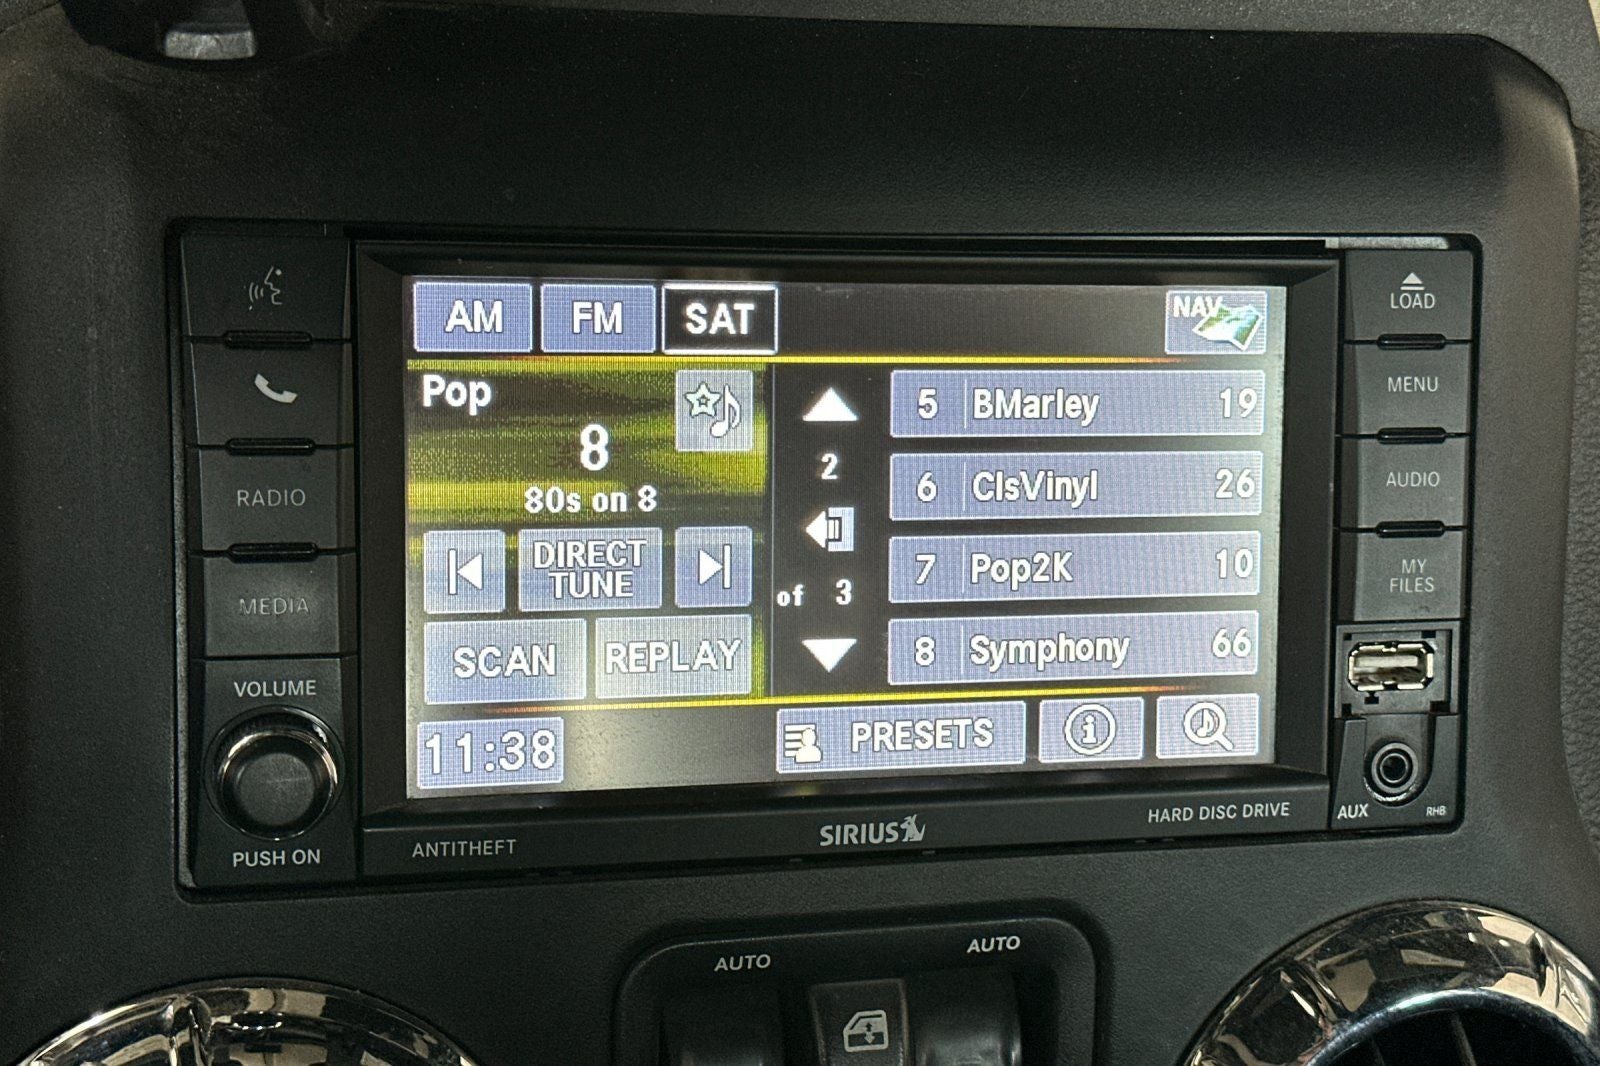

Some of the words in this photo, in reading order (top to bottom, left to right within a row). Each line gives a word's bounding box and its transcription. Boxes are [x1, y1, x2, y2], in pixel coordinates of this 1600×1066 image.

[1172, 296, 1224, 317] NAV
[1390, 293, 1435, 310] LOAD
[445, 300, 503, 333] AM
[572, 301, 623, 334] FM
[685, 303, 754, 335] SAT
[422, 375, 492, 415] Pop
[1387, 377, 1439, 393] MENU
[917, 388, 938, 419] 5
[973, 388, 1100, 426] BMarley
[1219, 388, 1258, 418] 19
[579, 424, 609, 471] 8
[820, 452, 839, 480] 2
[1386, 471, 1440, 487] AUDIO
[236, 489, 306, 507] RADIO
[524, 486, 581, 513] 80s
[592, 491, 627, 513] on
[637, 485, 658, 512] 8
[916, 471, 938, 502] 6
[972, 469, 1099, 508] ClsVinyl
[1215, 468, 1256, 499] 26
[533, 540, 647, 569] DIRECT
[1402, 559, 1427, 574] MY
[915, 554, 936, 585] 7
[970, 552, 1073, 590] Pop2K
[1216, 549, 1254, 579] 10
[548, 570, 634, 599] TUNE
[777, 585, 804, 607] of
[836, 579, 852, 605] 3
[1390, 577, 1435, 593] FILES
[240, 598, 309, 615] MEDIA
[453, 644, 557, 678] SCAN
[605, 639, 741, 674] REPLAY
[914, 635, 936, 666] 8
[970, 632, 1130, 671] Symphony
[1211, 628, 1252, 658] 66
[234, 680, 317, 698] VOLUME
[851, 718, 994, 753] PRESETS
[425, 730, 558, 775] 11:38
[1148, 806, 1194, 823] HARD
[1199, 804, 1237, 821] DISC
[1242, 802, 1290, 819] DRIVE
[1337, 804, 1369, 820] AUX
[412, 839, 517, 858] ANTITHEFT
[820, 822, 899, 847] SIRIUS
[233, 850, 285, 867] PUSH
[292, 848, 321, 865] ON
[967, 936, 1021, 954] AUTO
[714, 954, 771, 971] AUTO
